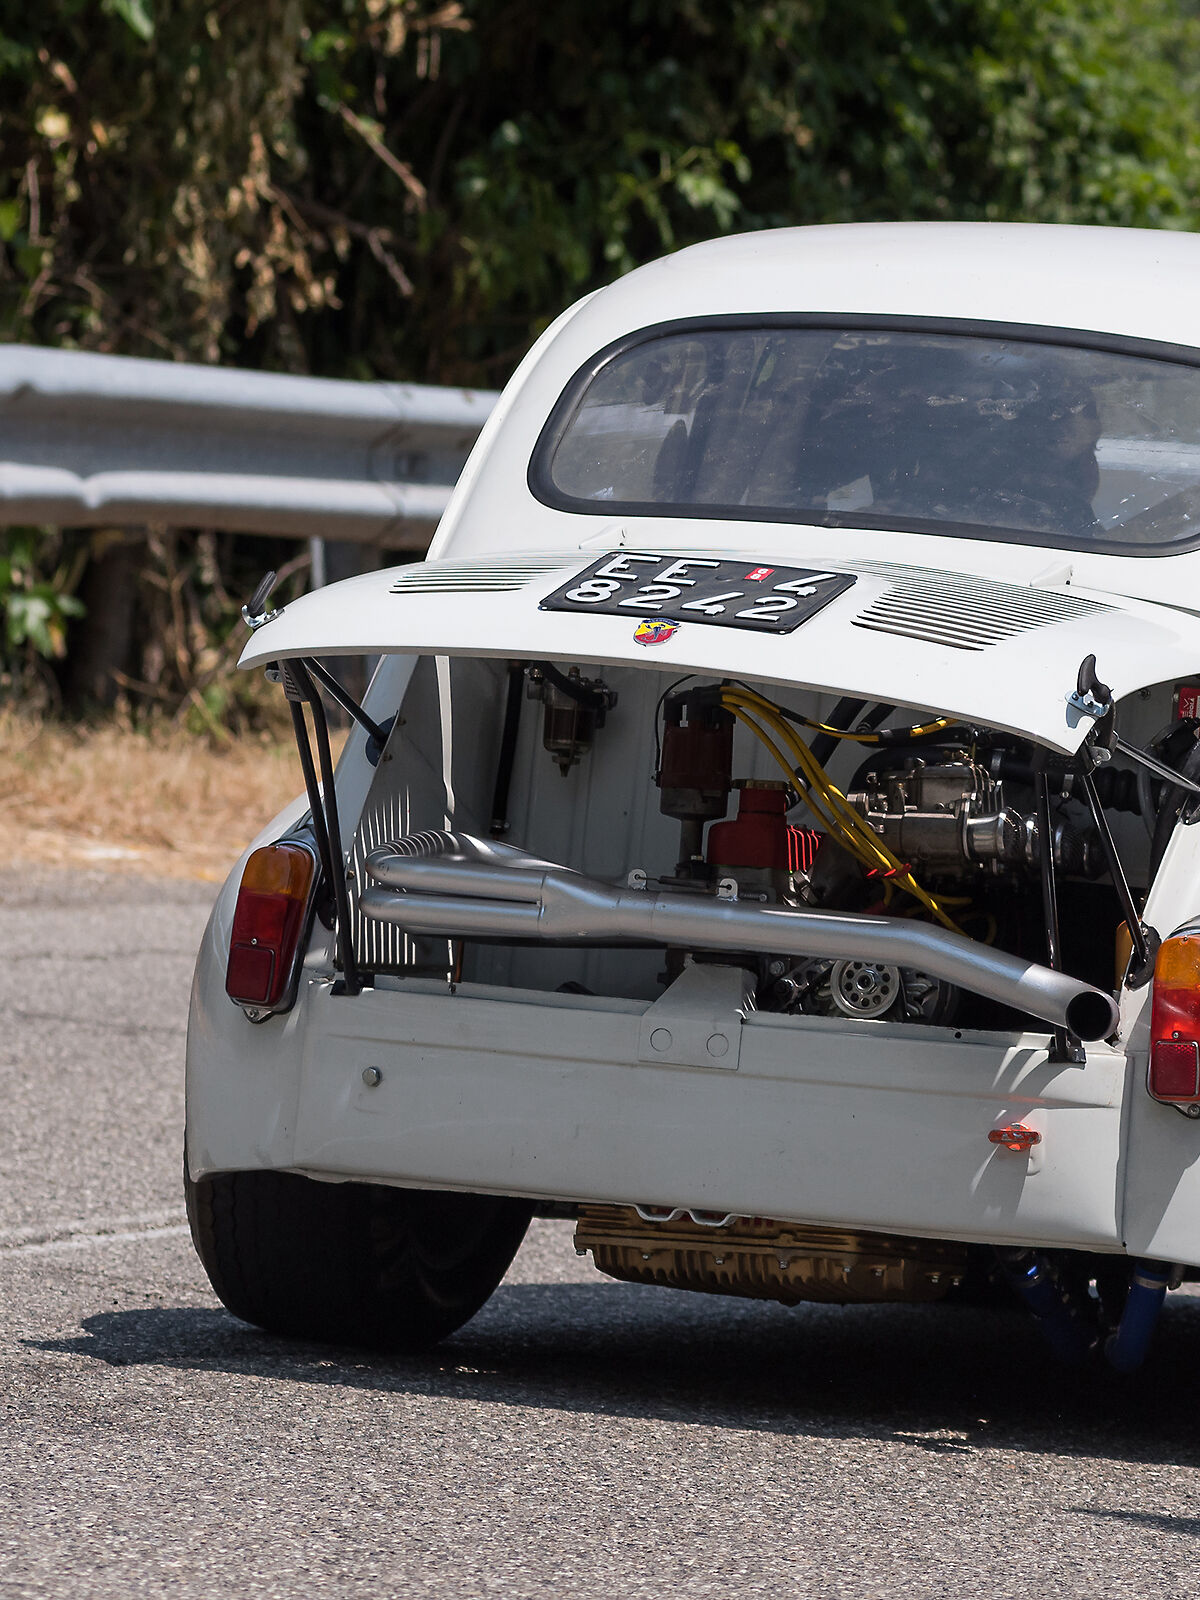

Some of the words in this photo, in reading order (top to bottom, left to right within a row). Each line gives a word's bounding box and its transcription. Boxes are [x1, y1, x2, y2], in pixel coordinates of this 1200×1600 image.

[594, 554, 720, 586] EE
[773, 574, 837, 597] 4
[565, 579, 798, 621] 8242
